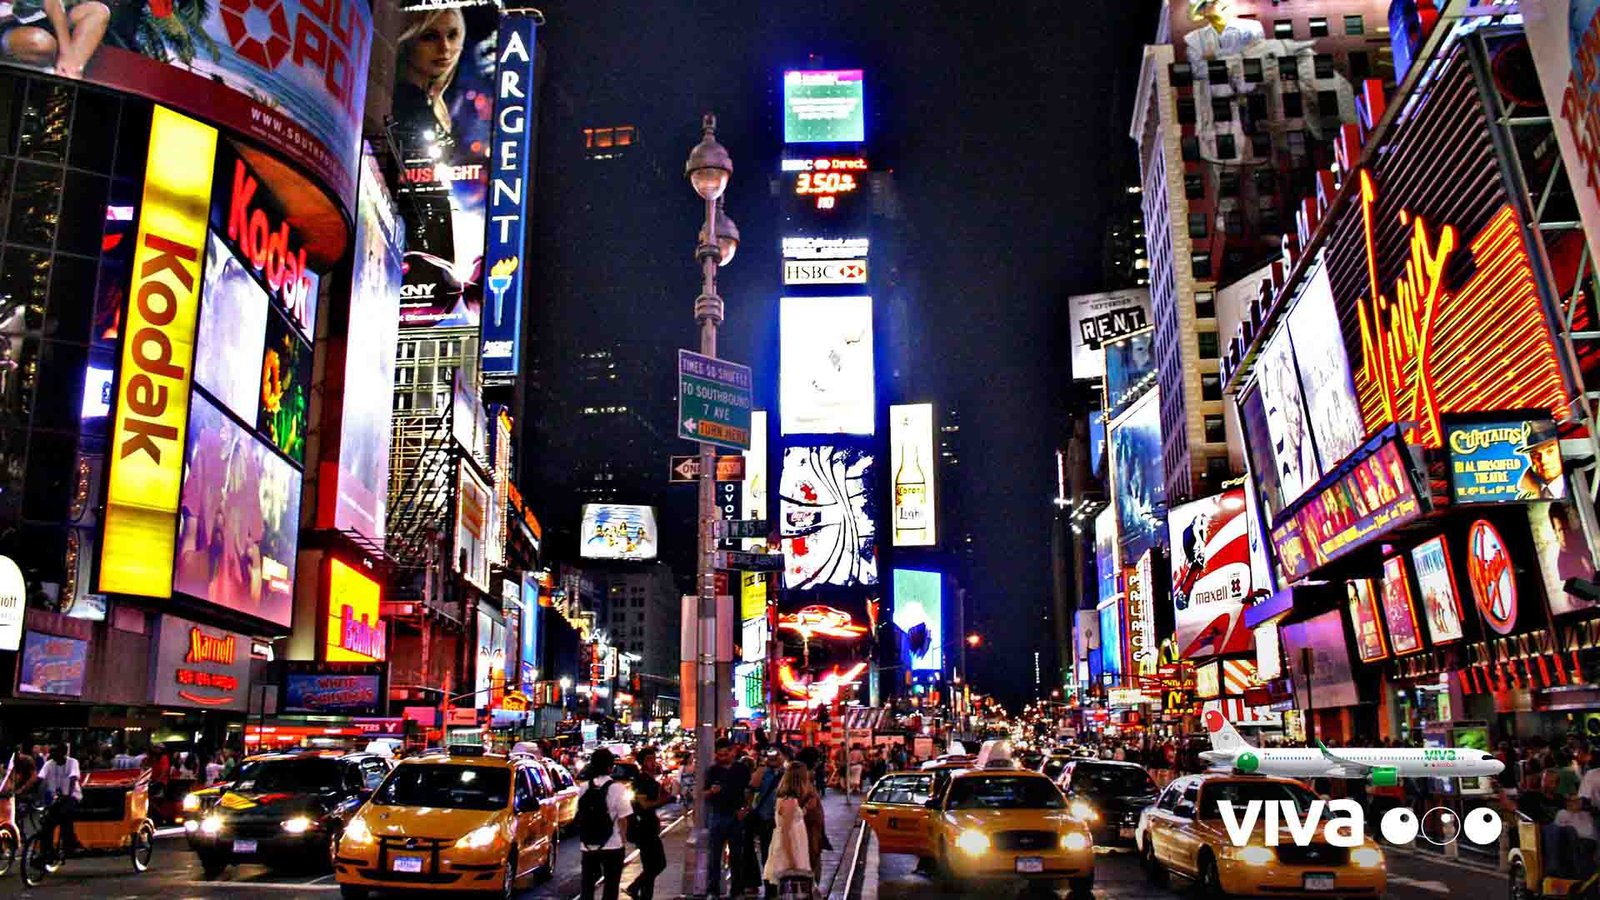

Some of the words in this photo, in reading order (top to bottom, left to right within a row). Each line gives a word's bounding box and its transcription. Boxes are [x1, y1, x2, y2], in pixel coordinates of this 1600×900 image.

[493, 31, 530, 244] ARGENT
[228, 158, 313, 331] Kodak
[787, 266, 835, 279] HSBC
[120, 233, 198, 466] Kodak
[682, 382, 694, 396] TO
[696, 385, 750, 409] SOUTHBOUND
[703, 403, 710, 416] 7
[713, 407, 731, 421] AVE
[1195, 585, 1229, 606] maxell
[186, 626, 235, 666] Marriott
